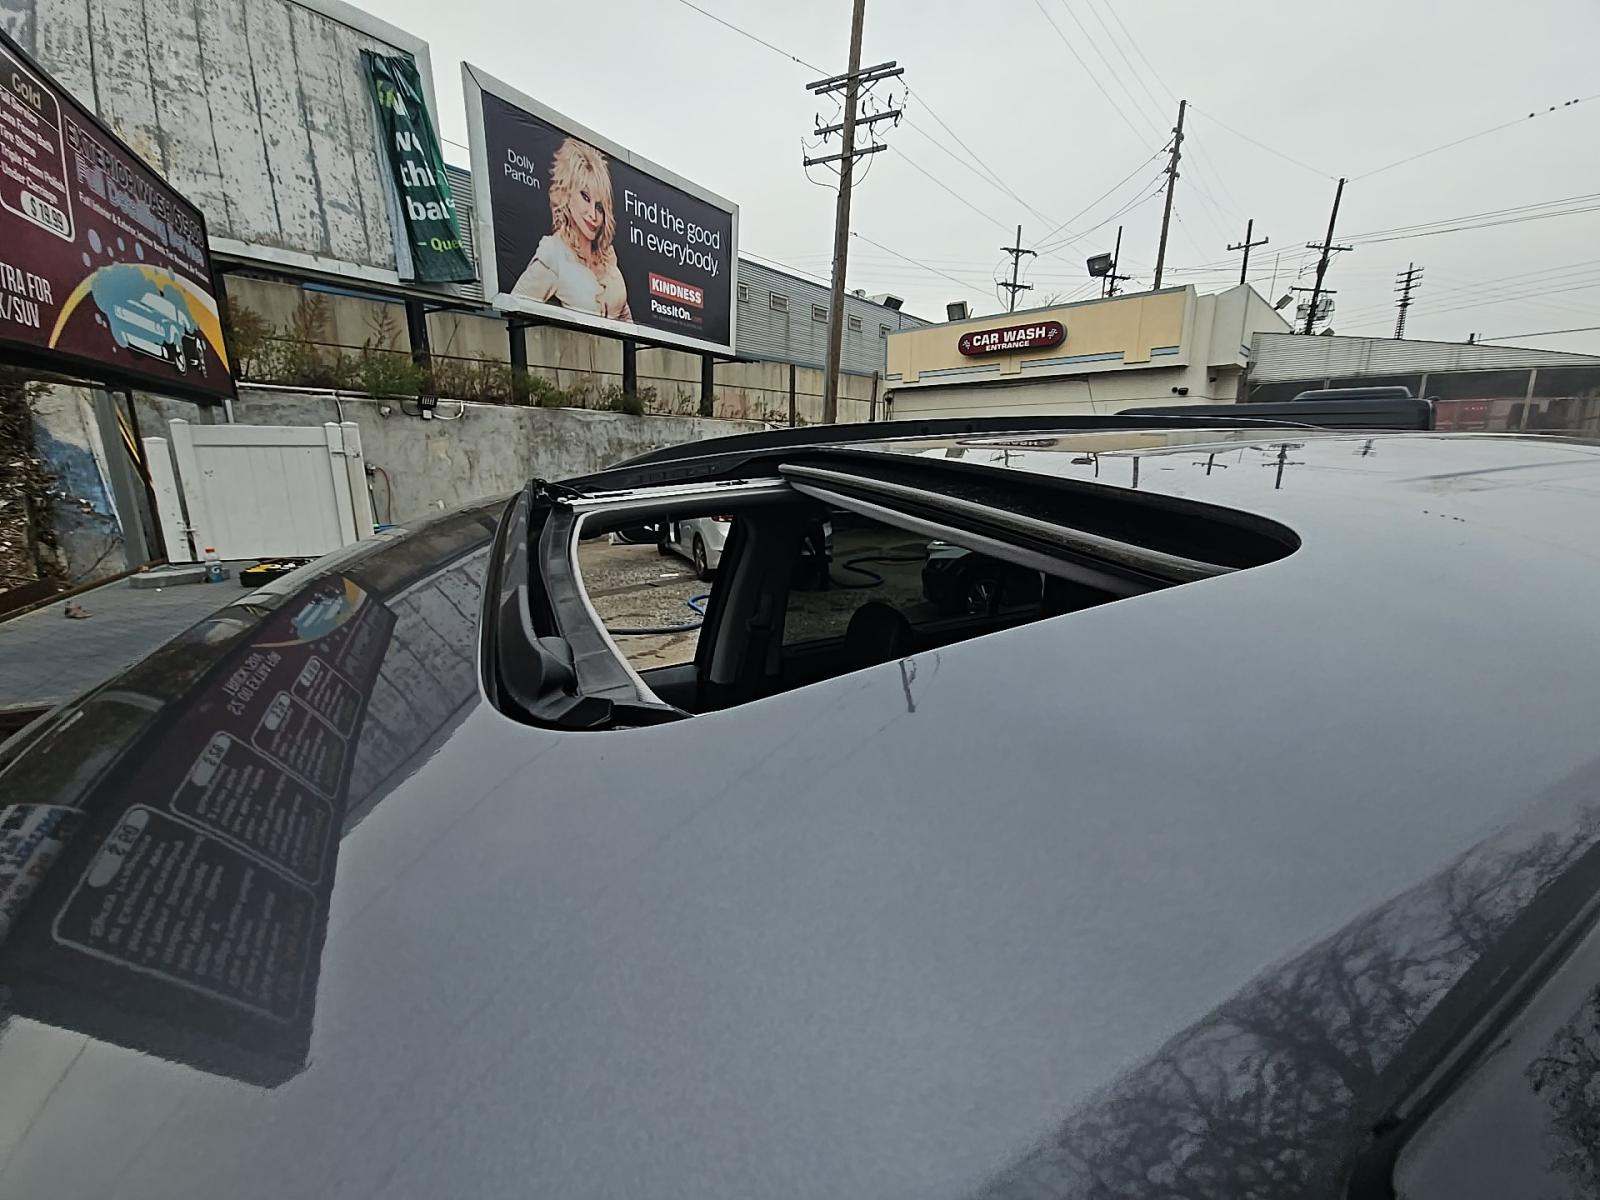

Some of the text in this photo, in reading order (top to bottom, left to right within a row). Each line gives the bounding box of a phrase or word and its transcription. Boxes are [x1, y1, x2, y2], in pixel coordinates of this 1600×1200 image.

[12, 73, 42, 110] Gold
[507, 149, 535, 172] Dolly
[504, 163, 541, 190] Parton
[624, 189, 720, 250] Find the good
[630, 220, 720, 277] in everybody.
[26, 272, 54, 305] FOR
[651, 277, 702, 304] KINDNESS
[972, 326, 1046, 346] CAR WASH
[985, 340, 1030, 351] ENTRANCE
